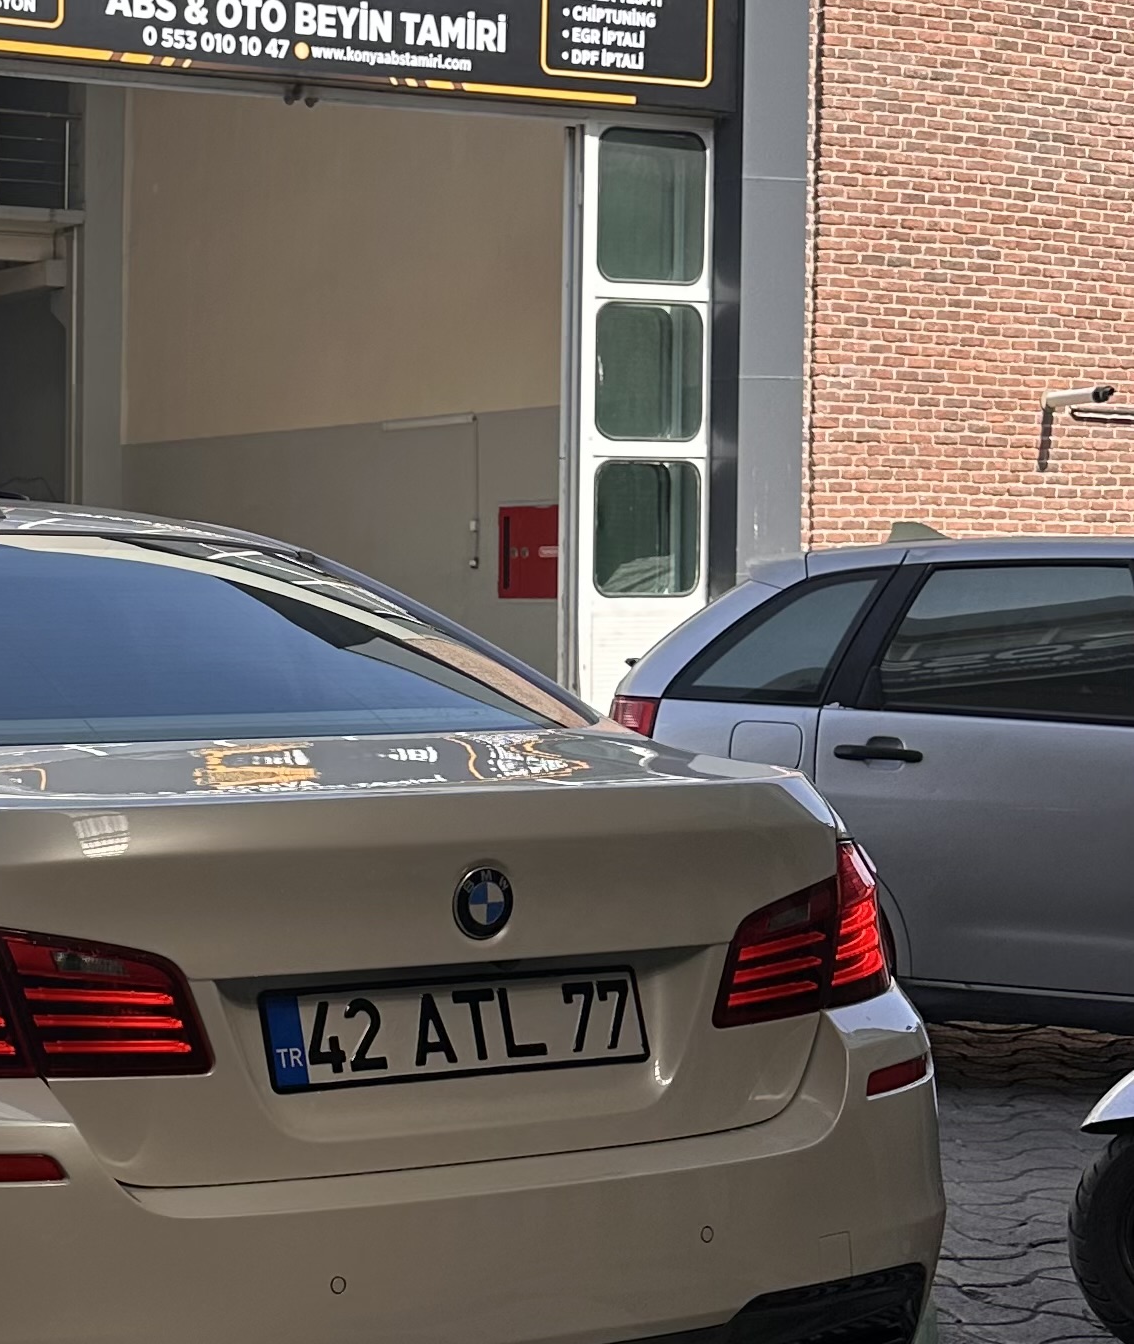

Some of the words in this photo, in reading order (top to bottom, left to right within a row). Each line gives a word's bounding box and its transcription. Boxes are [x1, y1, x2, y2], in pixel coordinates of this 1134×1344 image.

[294, 0, 392, 44] BEYİN
[399, 10, 507, 53] TAMİRİ
[571, 27, 600, 45] EGR
[142, 25, 158, 47] 0
[161, 27, 197, 51] 553
[200, 31, 236, 55] 010
[239, 35, 262, 57] 10
[265, 37, 290, 59] 47
[571, 48, 600, 66] DPF
[462, 869, 509, 894] BMW
[308, 997, 388, 1074] 42
[415, 987, 548, 1067] ATL
[561, 979, 629, 1054] 77
[276, 1047, 304, 1069] TR
